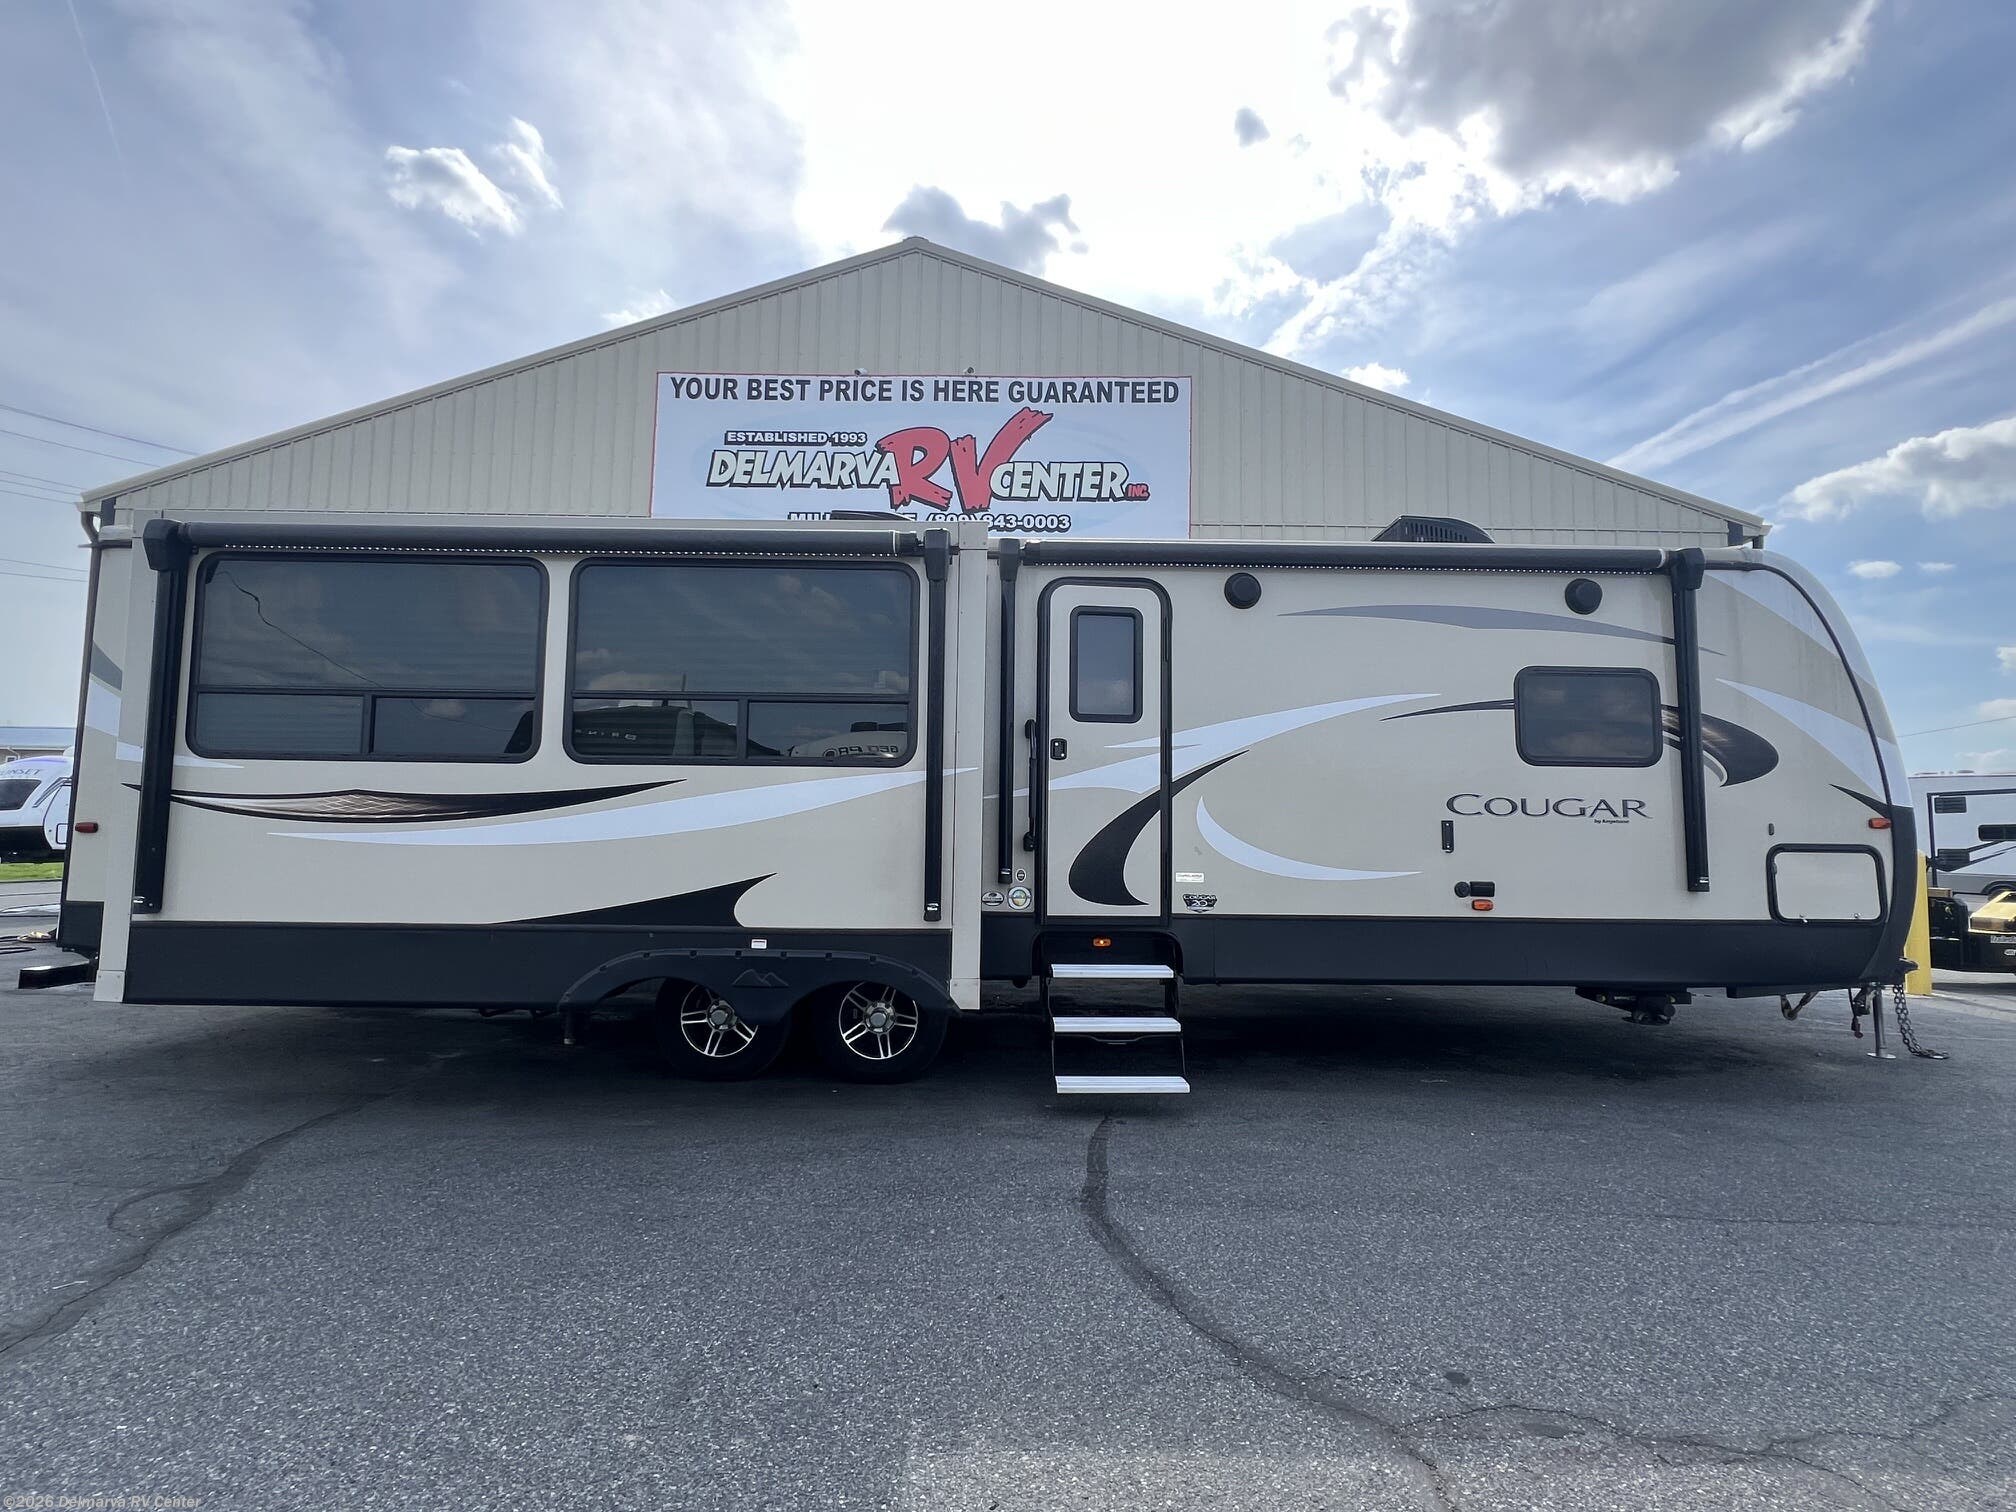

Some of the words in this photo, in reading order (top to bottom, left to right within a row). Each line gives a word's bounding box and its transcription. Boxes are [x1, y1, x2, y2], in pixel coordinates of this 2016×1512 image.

[671, 377, 738, 400] YOUR
[747, 378, 810, 401] BEST
[819, 379, 892, 402] PRICE
[902, 380, 924, 401] IS
[933, 380, 999, 403] HERE
[1008, 381, 1179, 403] GUARANTEED
[726, 431, 829, 444] ESTABLISHED
[832, 432, 867, 444] 1993
[707, 450, 899, 488] DELMARVA
[875, 407, 1054, 512] RV
[989, 461, 1128, 501] CENTER
[980, 513, 1071, 531] 843-0003
[1446, 793, 1653, 819] COUGAR
